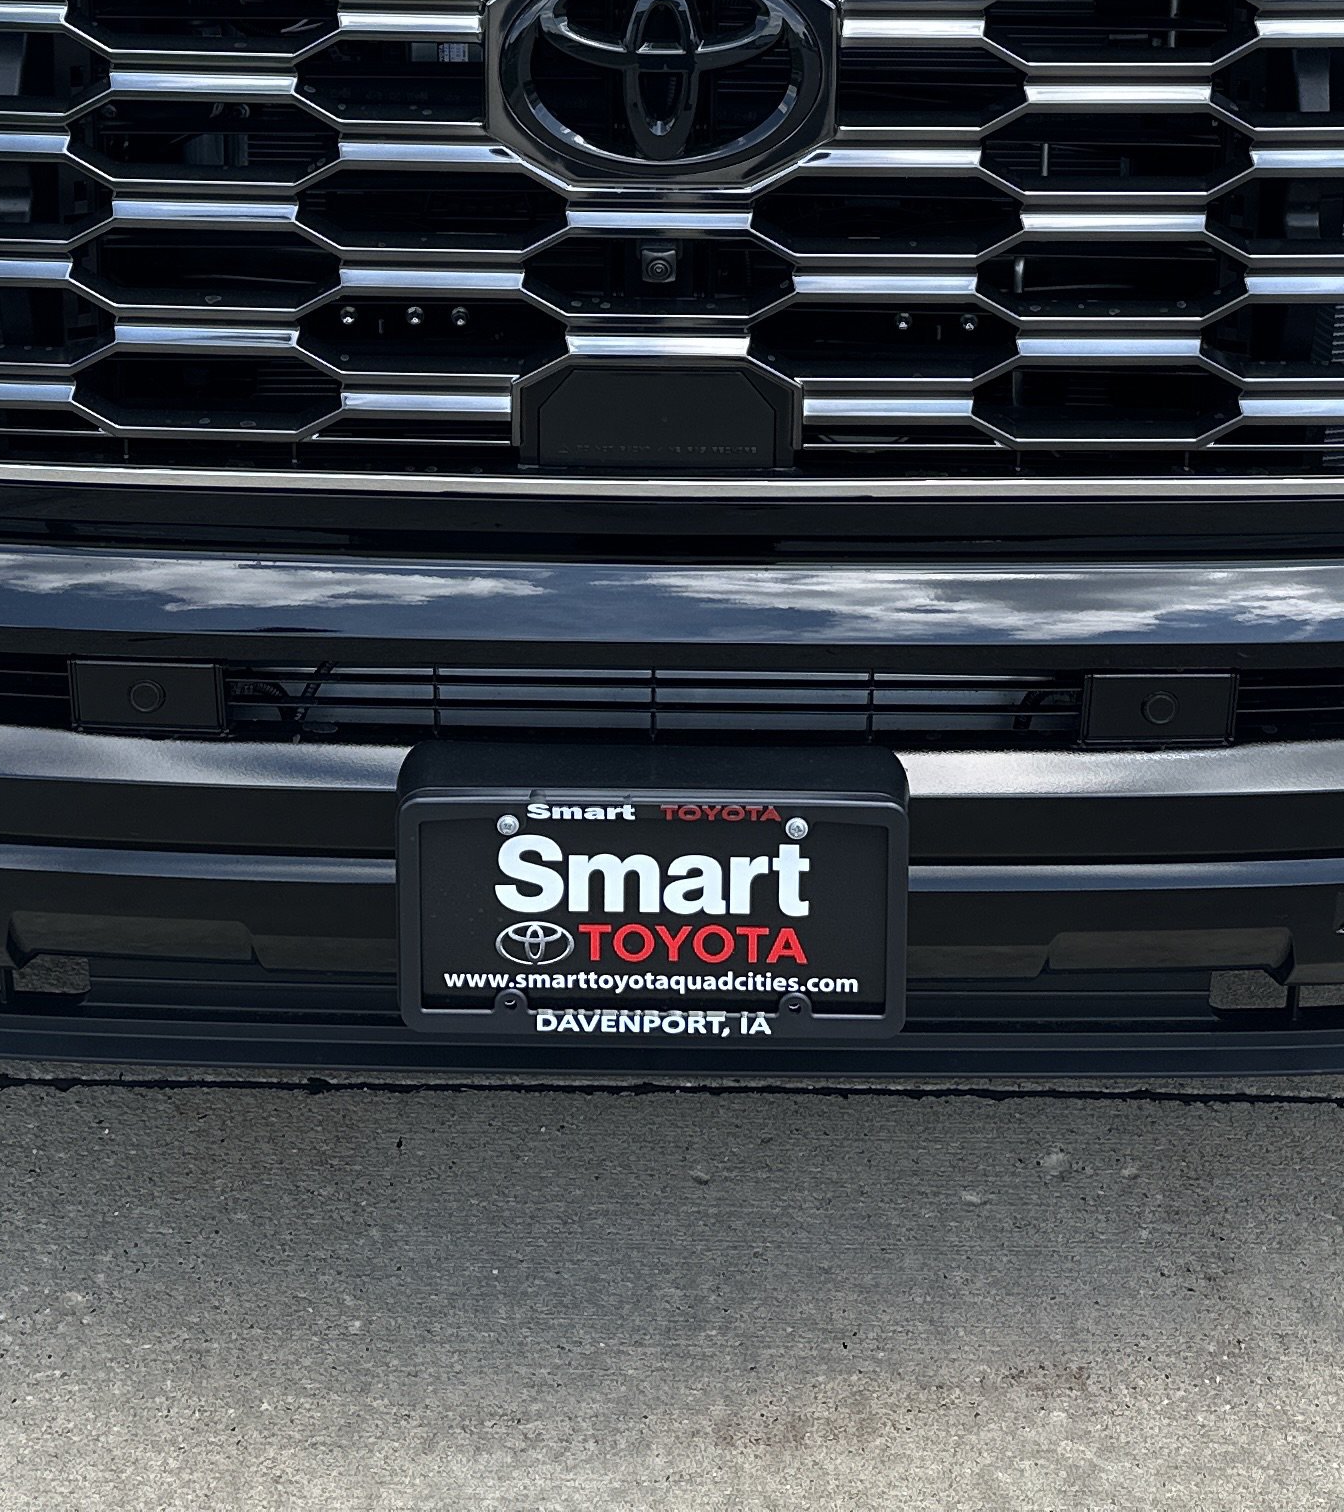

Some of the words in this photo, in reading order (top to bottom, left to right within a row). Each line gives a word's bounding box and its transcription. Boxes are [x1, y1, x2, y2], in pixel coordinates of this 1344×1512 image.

[527, 803, 636, 821] Smart
[660, 804, 782, 823] TOYOTA
[494, 834, 811, 918] Smart
[578, 923, 809, 965] TOYOTA
[444, 970, 859, 995] www.smarttoyotaquadcities.com
[536, 1012, 732, 1038] DAVENPORT,
[739, 1012, 773, 1036] IA
